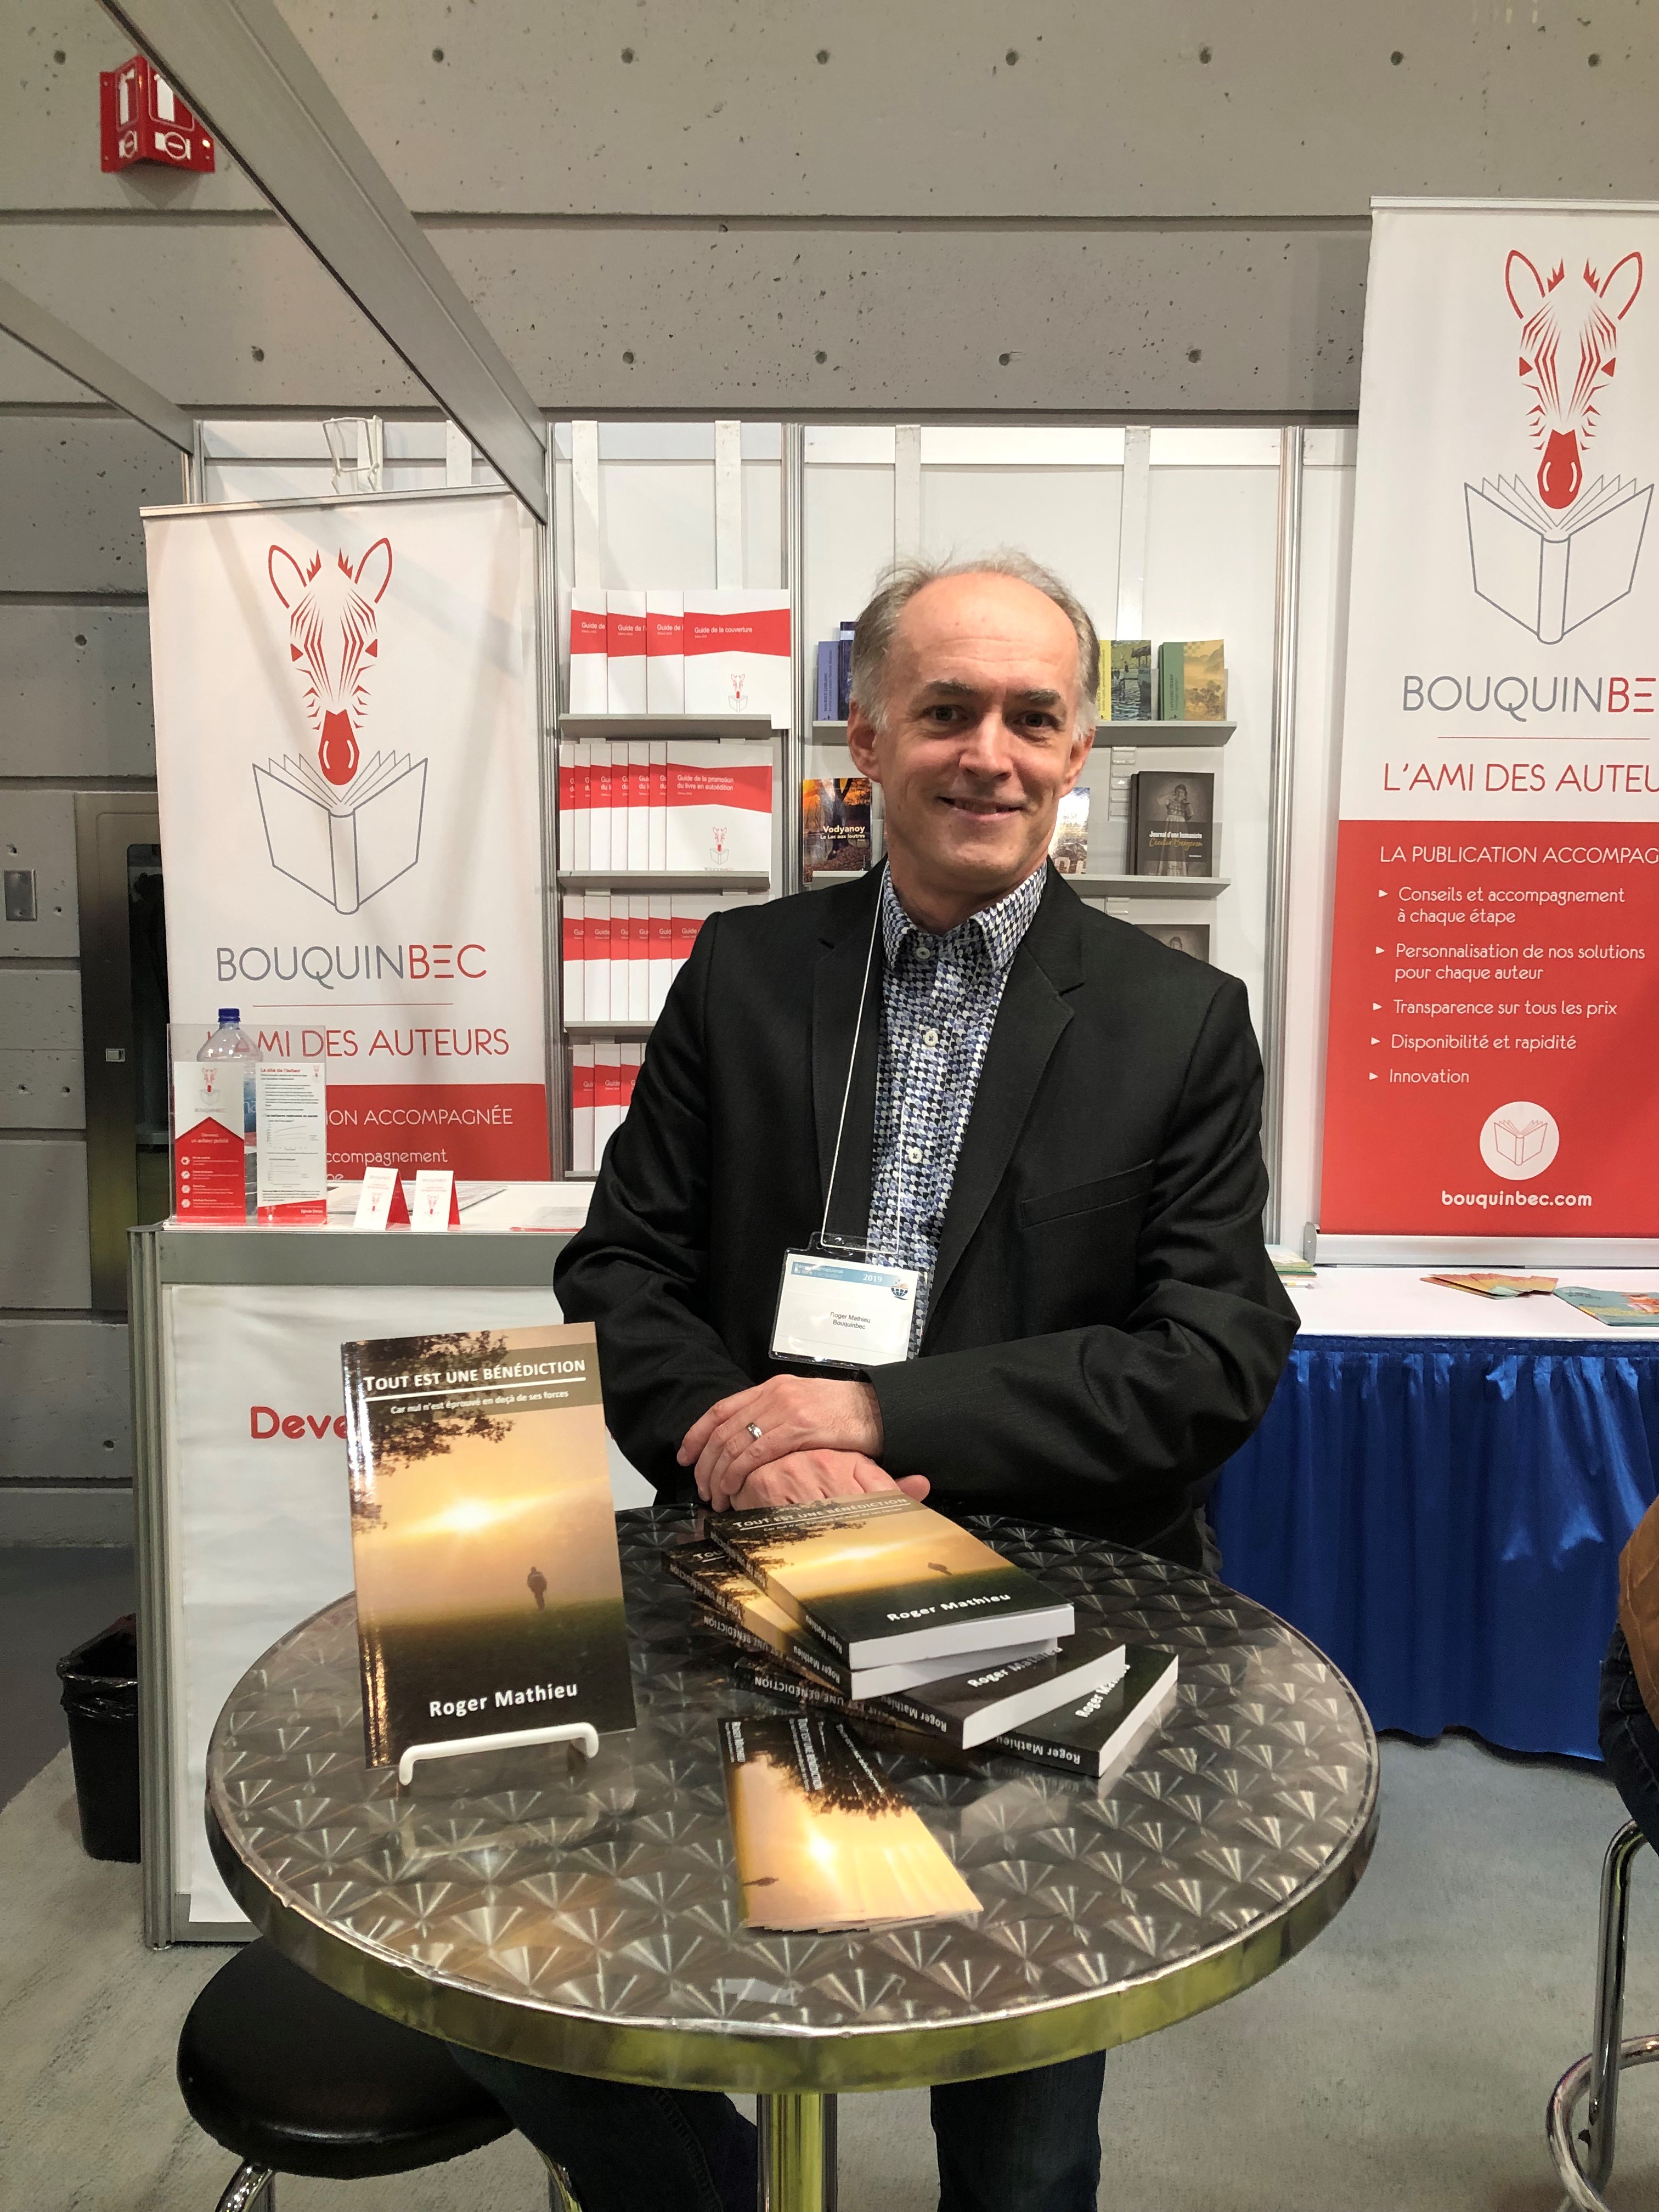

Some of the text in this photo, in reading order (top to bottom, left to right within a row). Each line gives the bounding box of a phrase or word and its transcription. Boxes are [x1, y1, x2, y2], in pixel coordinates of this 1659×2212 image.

[1403, 675, 1656, 722] BOUQUINBE
[1384, 763, 1659, 793] L'AMI DES AUTEU
[823, 825, 865, 834] Vodyanoy
[1380, 845, 1659, 864] LA PUBLICATION ACCOMPAG
[1398, 887, 1626, 906] Conseils et accompagnement
[1397, 909, 1516, 926] à chaque étape
[1396, 943, 1645, 960] Personnalisation de nos solutions
[217, 944, 487, 989] BOUQUINBEC
[1395, 965, 1544, 983] pour chaque auteur
[1393, 999, 1618, 1018] Transparence sur tous les prix
[302, 1029, 358, 1057] DES
[369, 1028, 509, 1056] AUTEURS
[1391, 1034, 1577, 1052] Disponibilité et rapidité
[1389, 1069, 1470, 1084] Innovation
[364, 1104, 514, 1126] ACCOMPAGNÉE
[327, 1149, 448, 1166] ccompagnement
[1441, 1190, 1592, 1210] bouquinbec.com
[862, 1273, 883, 1283] 2019
[830, 1312, 871, 1323] Roger Mathieu
[833, 1319, 866, 1330] Bouquinbec
[363, 1359, 586, 1391] TOUT EST UNE BÉNÉDICTION
[391, 1406, 405, 1414] Car
[516, 1393, 527, 1402] de
[543, 1390, 569, 1399] forces
[251, 1406, 347, 1440] Deve
[733, 1517, 769, 1528] TOUT
[774, 1514, 795, 1522] EST
[798, 1510, 823, 1519] UNE
[887, 1593, 1011, 1622] Roger Mathieu
[793, 1645, 820, 1671] Mathieu
[967, 1668, 1009, 1688] Roger
[429, 1681, 578, 1718] Roger Mathieu
[919, 1712, 947, 1733] Roger
[996, 1736, 1081, 1765] Roger Mathieu
